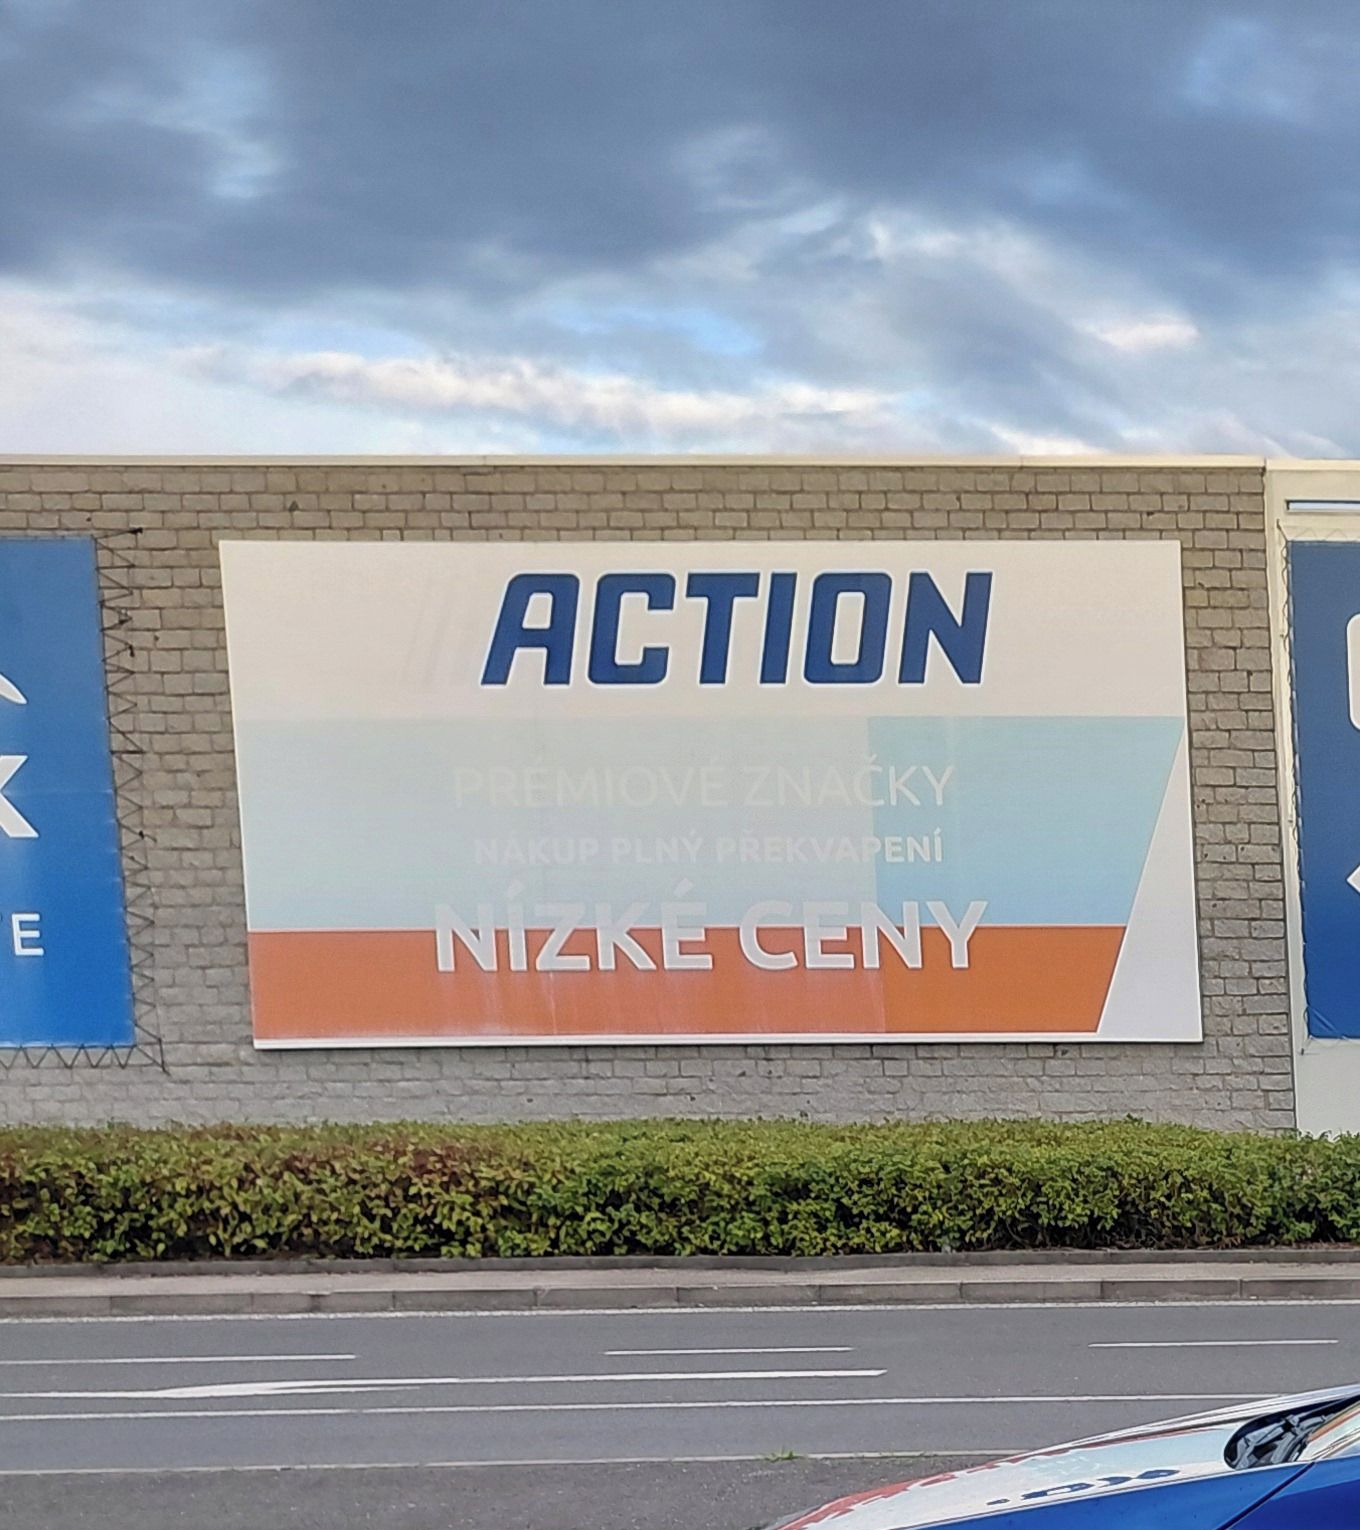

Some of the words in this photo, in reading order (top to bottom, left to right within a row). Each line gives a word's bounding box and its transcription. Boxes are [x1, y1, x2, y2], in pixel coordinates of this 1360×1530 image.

[479, 571, 994, 687] ACTION
[456, 753, 729, 808] PRÉMIOVÉ
[743, 753, 954, 807] ZNAČKY
[473, 829, 599, 865] NÁKUP
[611, 829, 701, 864] PLNÝ
[716, 827, 943, 863] PŘEKVAPENÍ
[435, 878, 714, 972] NÍZKÉ
[738, 900, 988, 971] CENY
